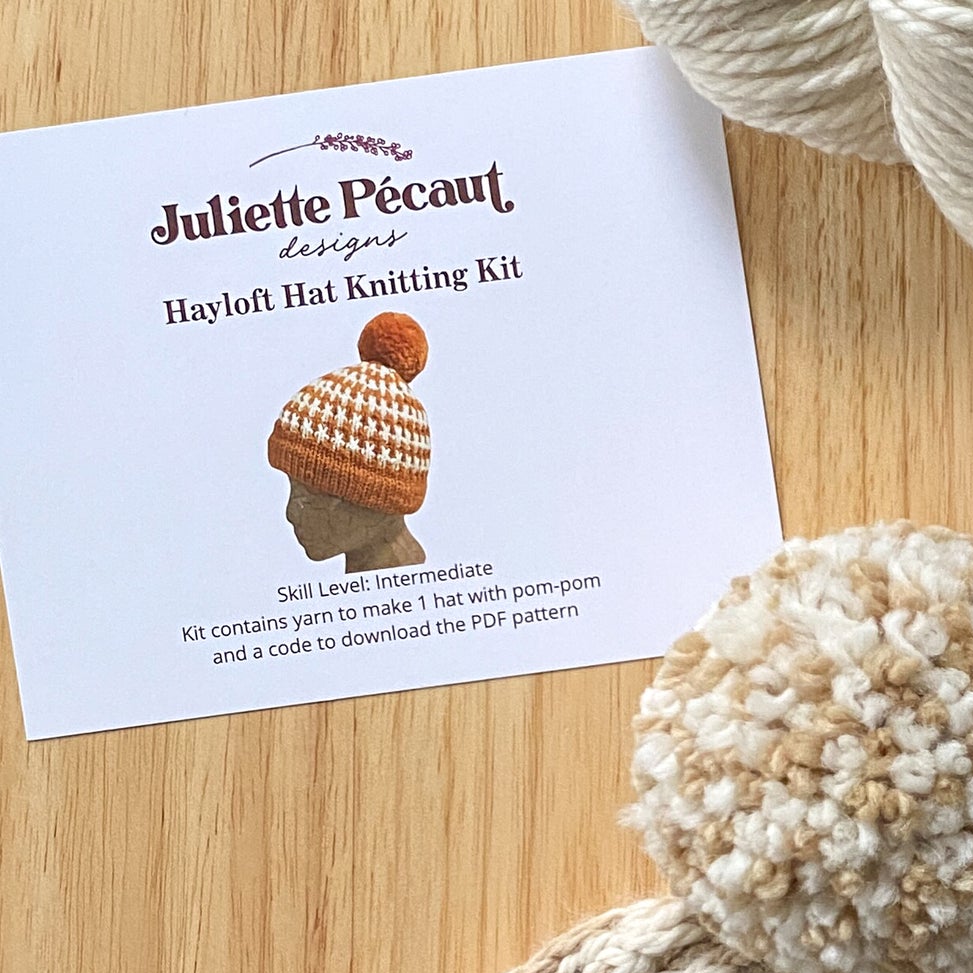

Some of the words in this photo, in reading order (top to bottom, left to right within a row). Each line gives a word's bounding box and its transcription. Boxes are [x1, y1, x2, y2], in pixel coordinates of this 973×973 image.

[150, 184, 332, 246] Juliette
[337, 160, 515, 220] Pécaut
[278, 228, 408, 262] designs
[162, 287, 276, 325] Hayloft
[280, 279, 339, 309] Hat
[343, 265, 469, 301] Knitting
[474, 255, 524, 284] Kit
[181, 625, 207, 643] Kit
[211, 615, 288, 639] contains
[291, 610, 334, 633] yarn
[338, 608, 356, 621] to
[362, 598, 413, 619] make
[418, 596, 425, 610] 1
[433, 592, 464, 609] hat
[467, 584, 507, 604] with
[512, 575, 601, 603] pom-pom
[277, 582, 313, 603] Skill
[318, 575, 371, 598] Level:
[375, 562, 493, 590] Intermediate
[213, 644, 248, 665] and
[253, 647, 262, 659] a
[268, 637, 313, 657] code
[317, 638, 335, 650] to
[341, 620, 432, 648] download
[435, 617, 466, 635] the
[471, 610, 507, 631] PDF
[512, 605, 579, 630] pattern
